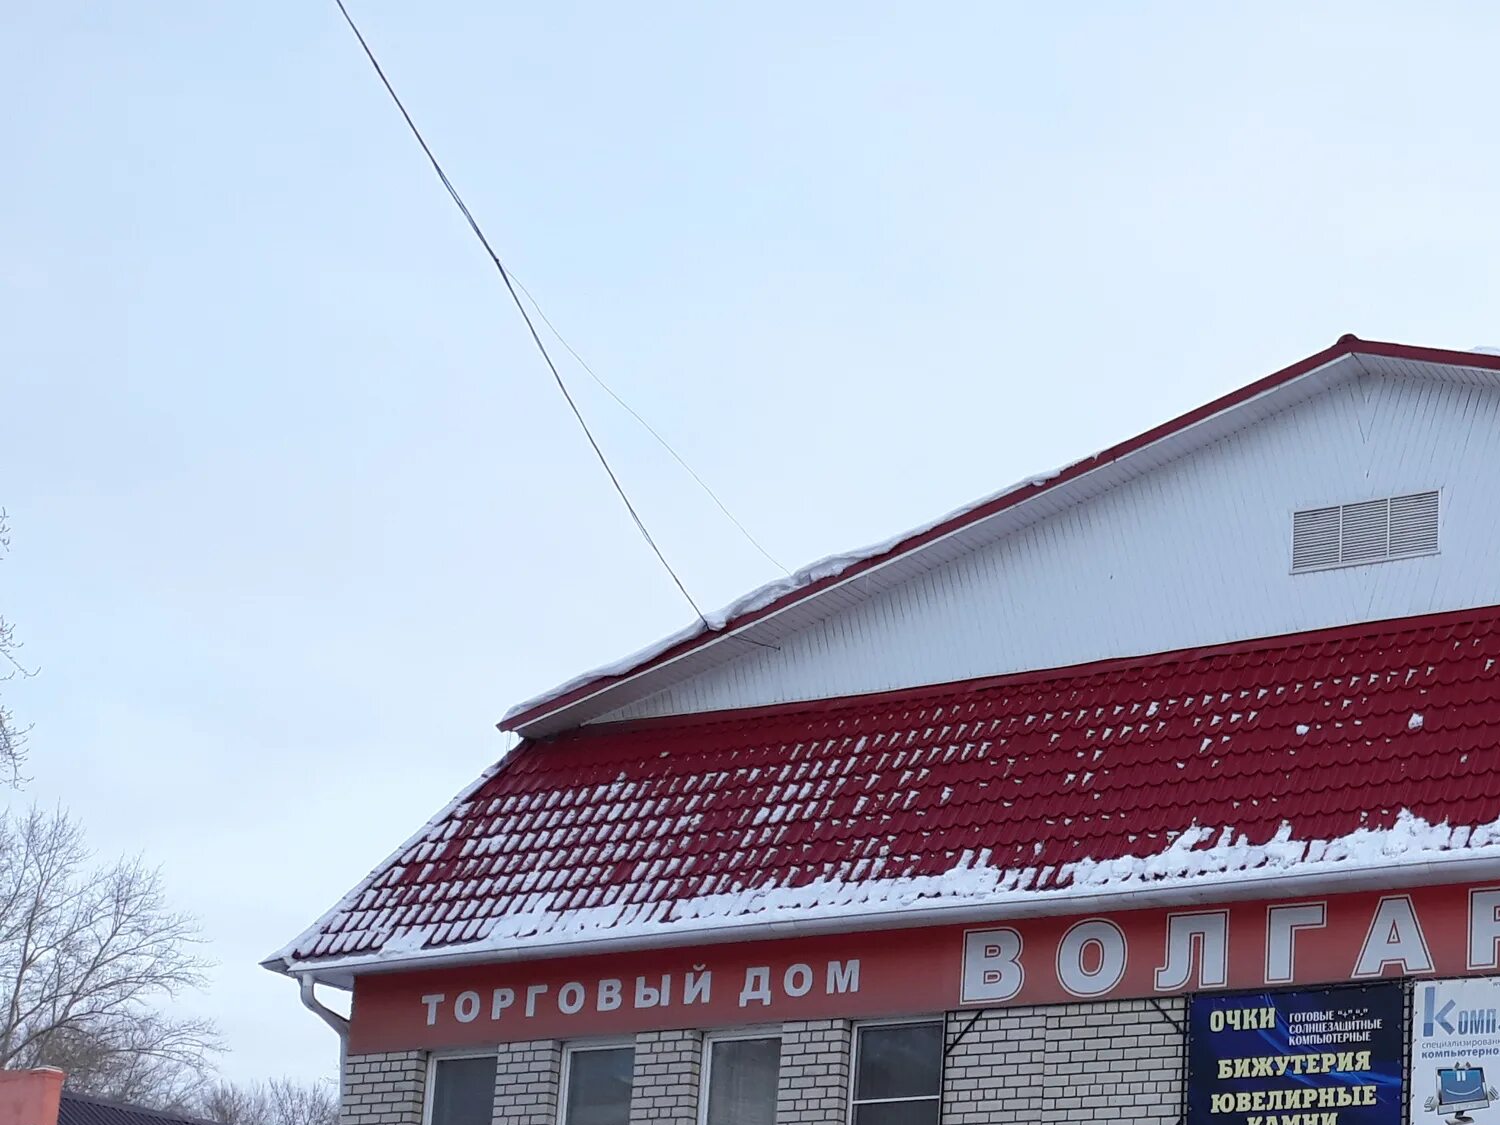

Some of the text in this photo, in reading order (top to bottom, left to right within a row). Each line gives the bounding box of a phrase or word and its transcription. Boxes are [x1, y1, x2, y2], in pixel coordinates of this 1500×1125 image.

[421, 959, 860, 1025] ТОРГОВЫЙ ДОМ
[1210, 1007, 1275, 1032] ОЧКИ
[1289, 1019, 1382, 1034] СОЛНЦЕЗАЩИТНЫЕ
[1289, 1031, 1371, 1046] КОМПЬЮТЕРНЫЕ
[1217, 1051, 1371, 1079] БИЖУТЕРИЯ
[1210, 1086, 1377, 1113] ЮВЕЛИРНЫЕ
